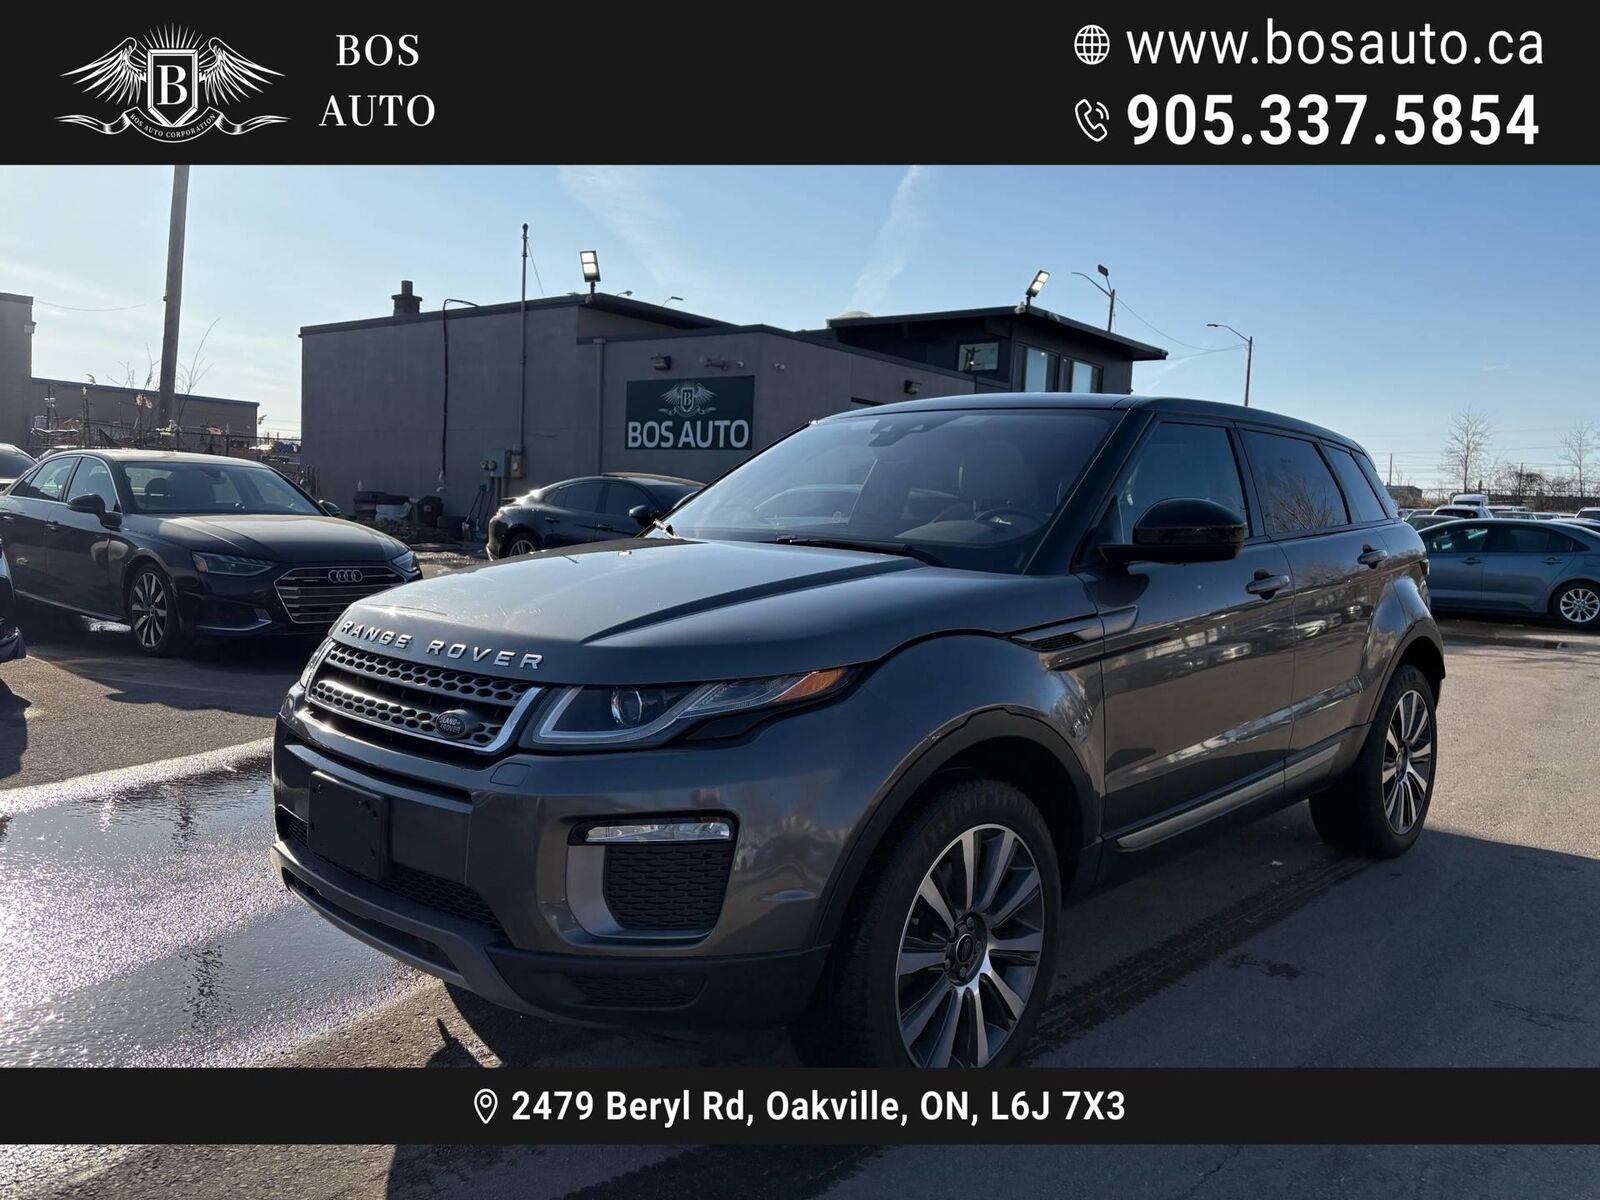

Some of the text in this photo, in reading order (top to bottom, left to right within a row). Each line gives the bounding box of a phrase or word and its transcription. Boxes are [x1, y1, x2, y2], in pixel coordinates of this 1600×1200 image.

[683, 391, 692, 406] B
[627, 419, 750, 448] BOS AUTO
[340, 620, 544, 670] RANGE ROVER
